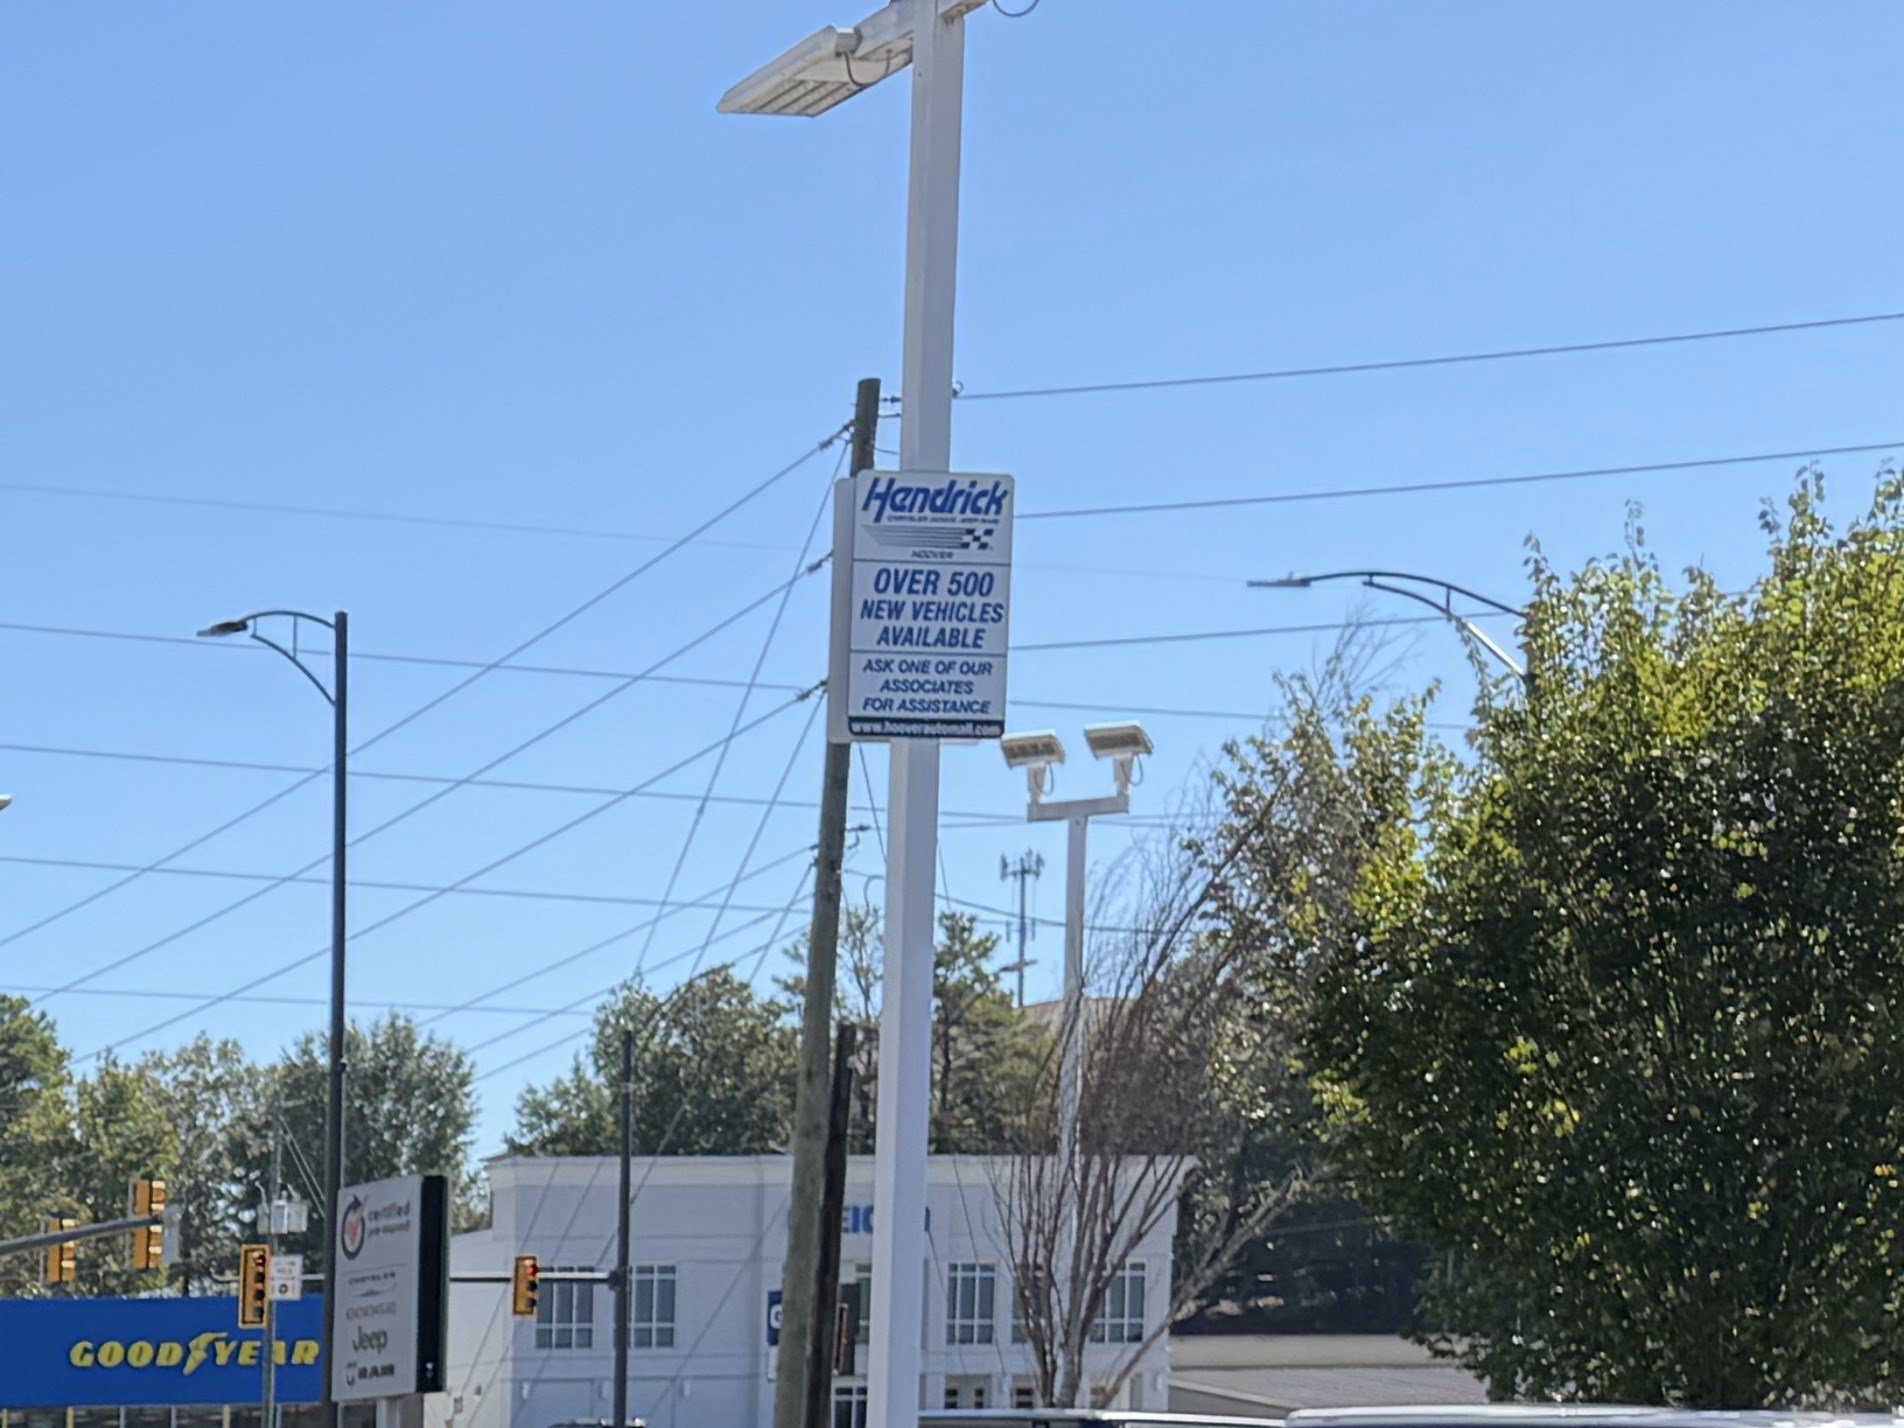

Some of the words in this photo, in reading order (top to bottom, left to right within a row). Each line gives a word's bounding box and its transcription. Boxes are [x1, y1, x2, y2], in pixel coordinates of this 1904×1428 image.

[861, 477, 1008, 523] Hendrick
[874, 568, 940, 595] OVER
[947, 571, 994, 597] 500
[860, 599, 906, 620] NEW
[911, 601, 1004, 623] VEHICLES
[876, 625, 986, 649] AVAILABLE
[863, 658, 895, 672] ASK
[898, 660, 930, 674] ONE
[934, 660, 957, 674] OF
[960, 661, 993, 675] OUR
[880, 679, 974, 694] ASSOCIATES
[863, 697, 894, 711] FOR
[896, 698, 991, 714] ASSISTANCE
[352, 1326, 388, 1354] Jeep
